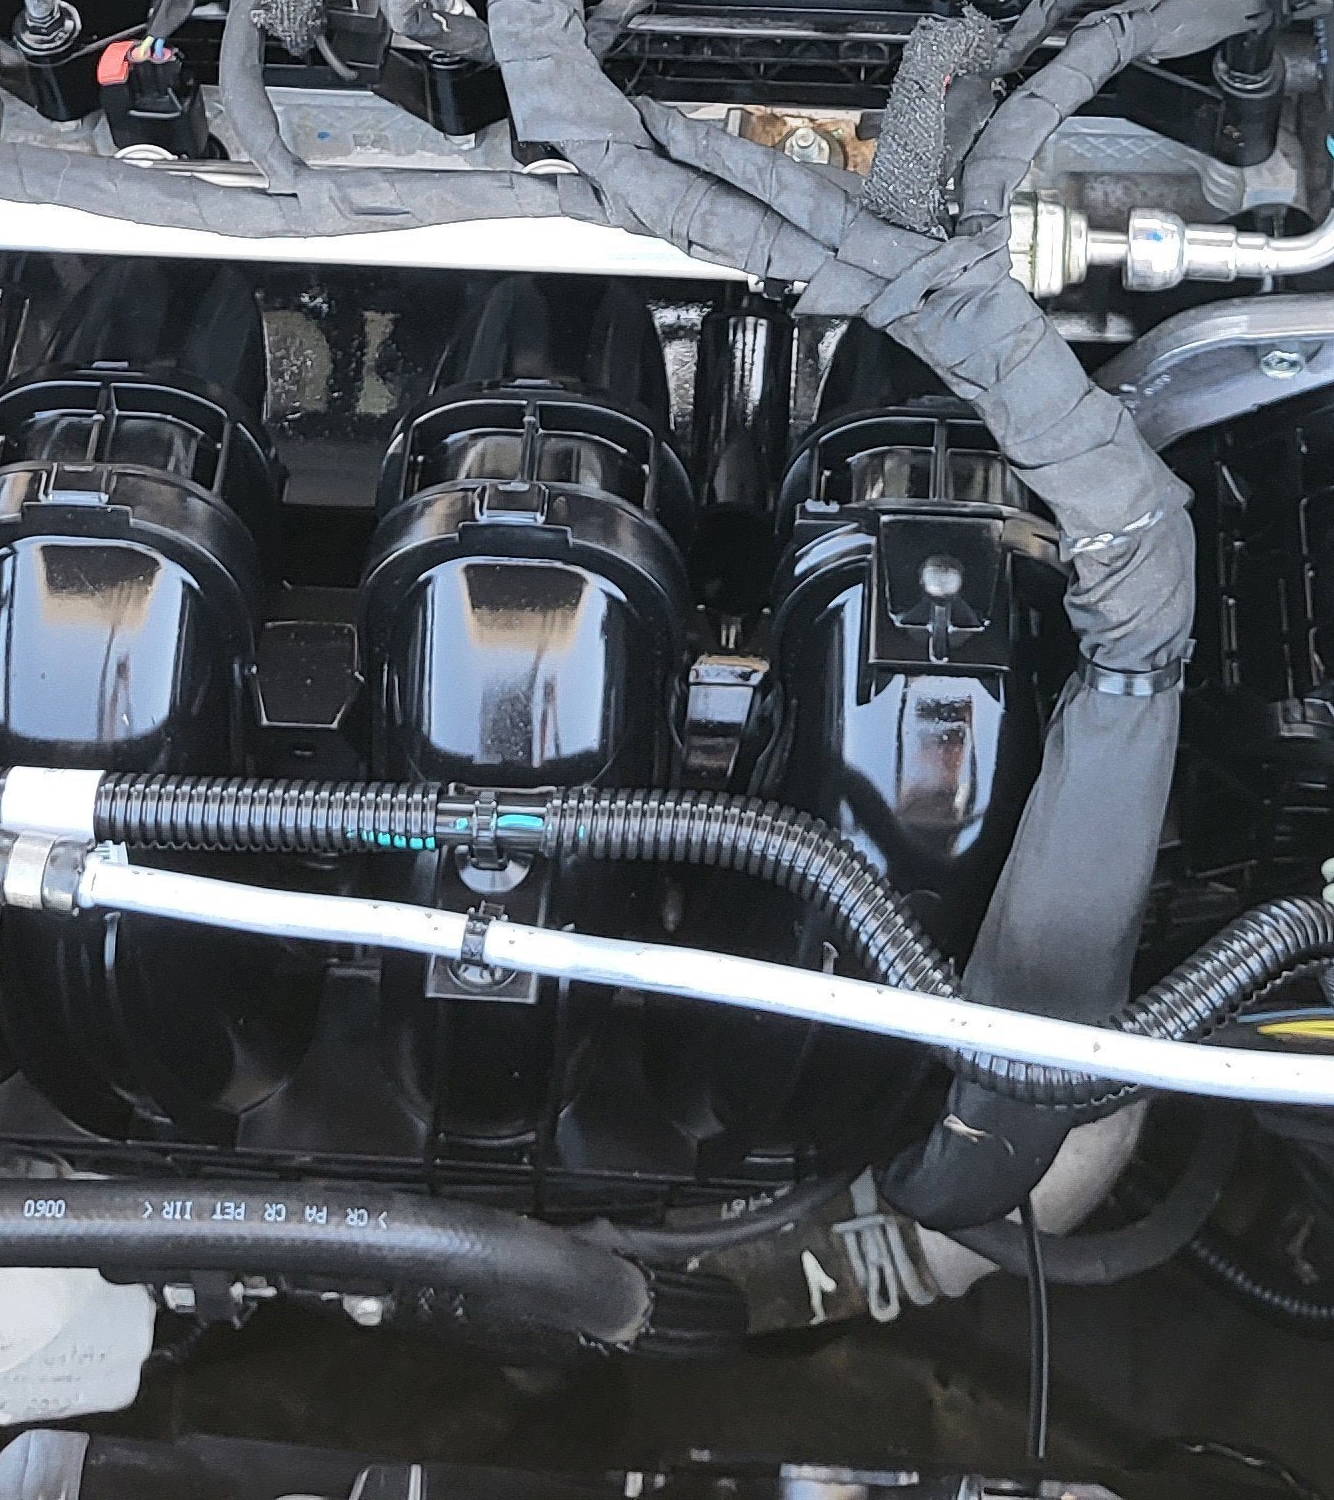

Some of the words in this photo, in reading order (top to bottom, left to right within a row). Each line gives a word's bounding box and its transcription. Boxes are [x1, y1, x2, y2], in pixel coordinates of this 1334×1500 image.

[24, 1199, 66, 1217] 0060
[211, 1201, 246, 1220] PET
[264, 1203, 287, 1222] CR
[304, 1205, 328, 1224] PA
[345, 1207, 369, 1226] CR
